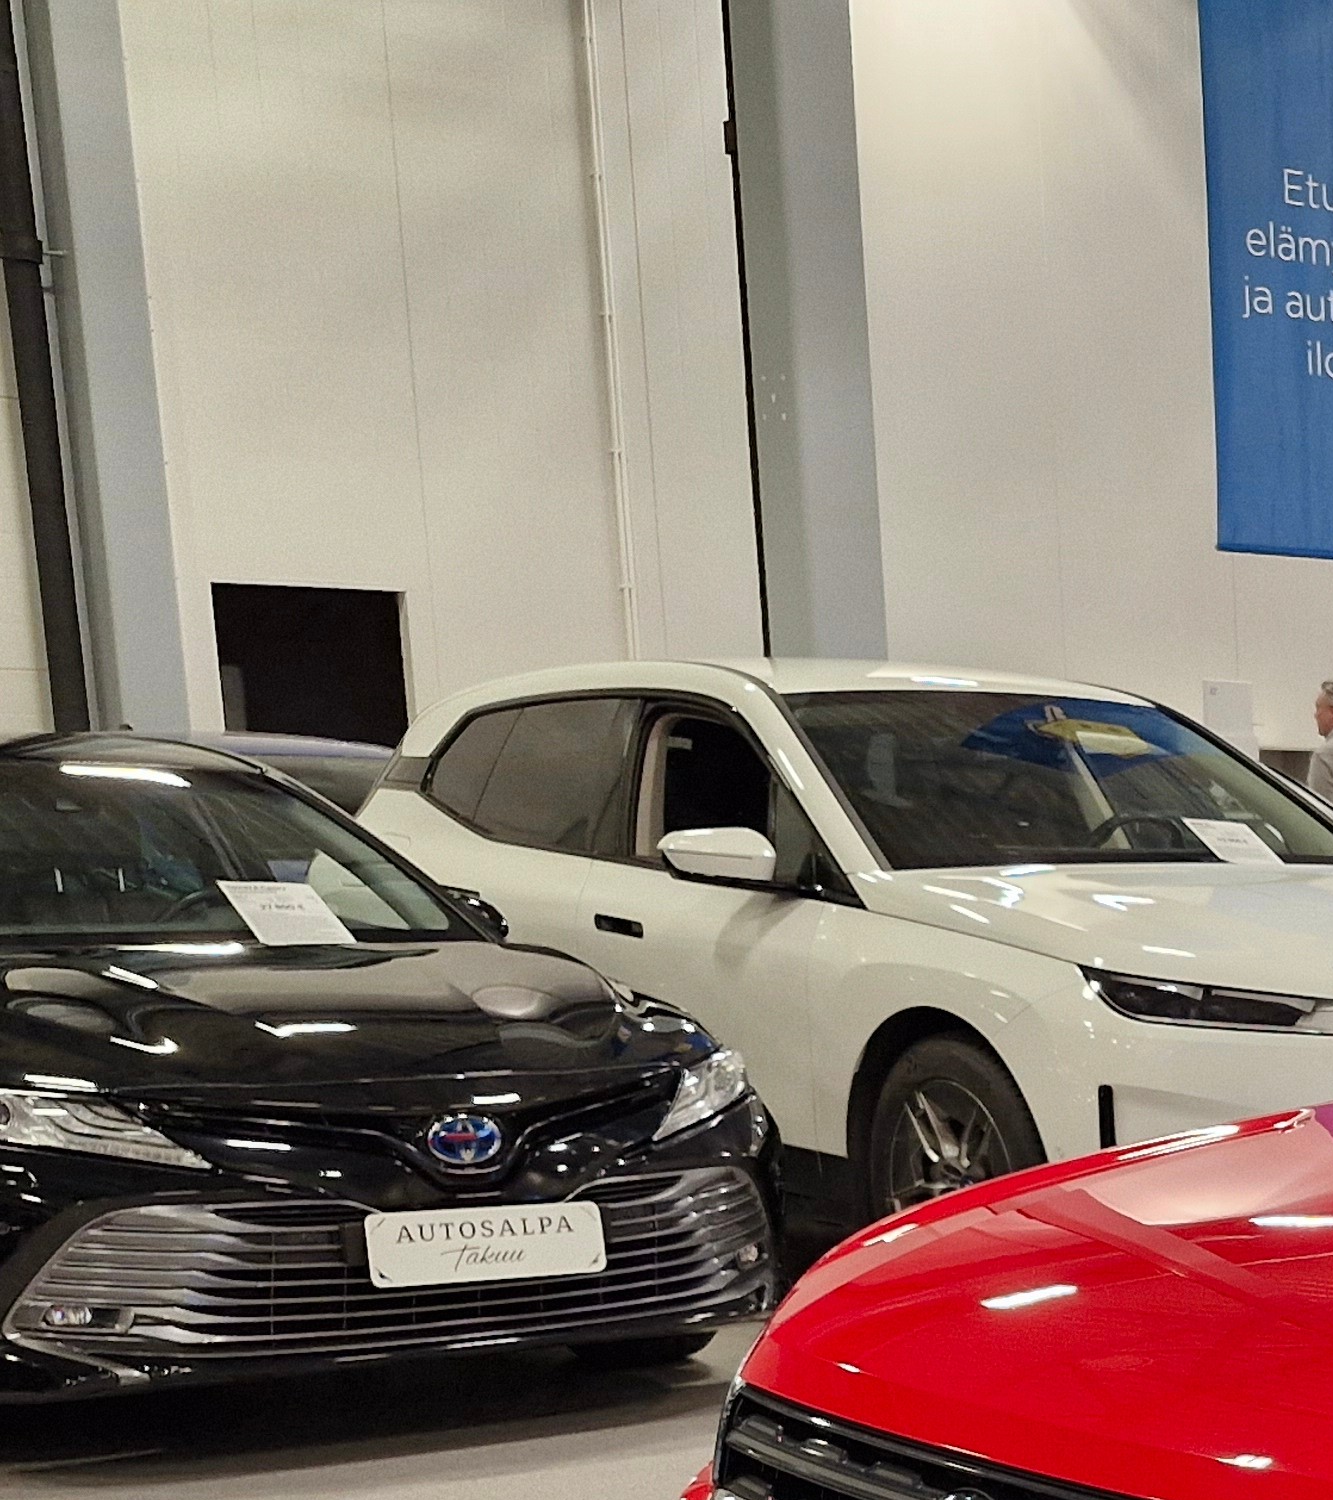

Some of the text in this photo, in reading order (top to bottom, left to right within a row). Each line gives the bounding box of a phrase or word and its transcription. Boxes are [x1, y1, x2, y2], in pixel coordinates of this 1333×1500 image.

[1242, 276, 1273, 319] ja
[396, 1215, 574, 1244] AUTOSALPA
[441, 1244, 526, 1272] Takuu
